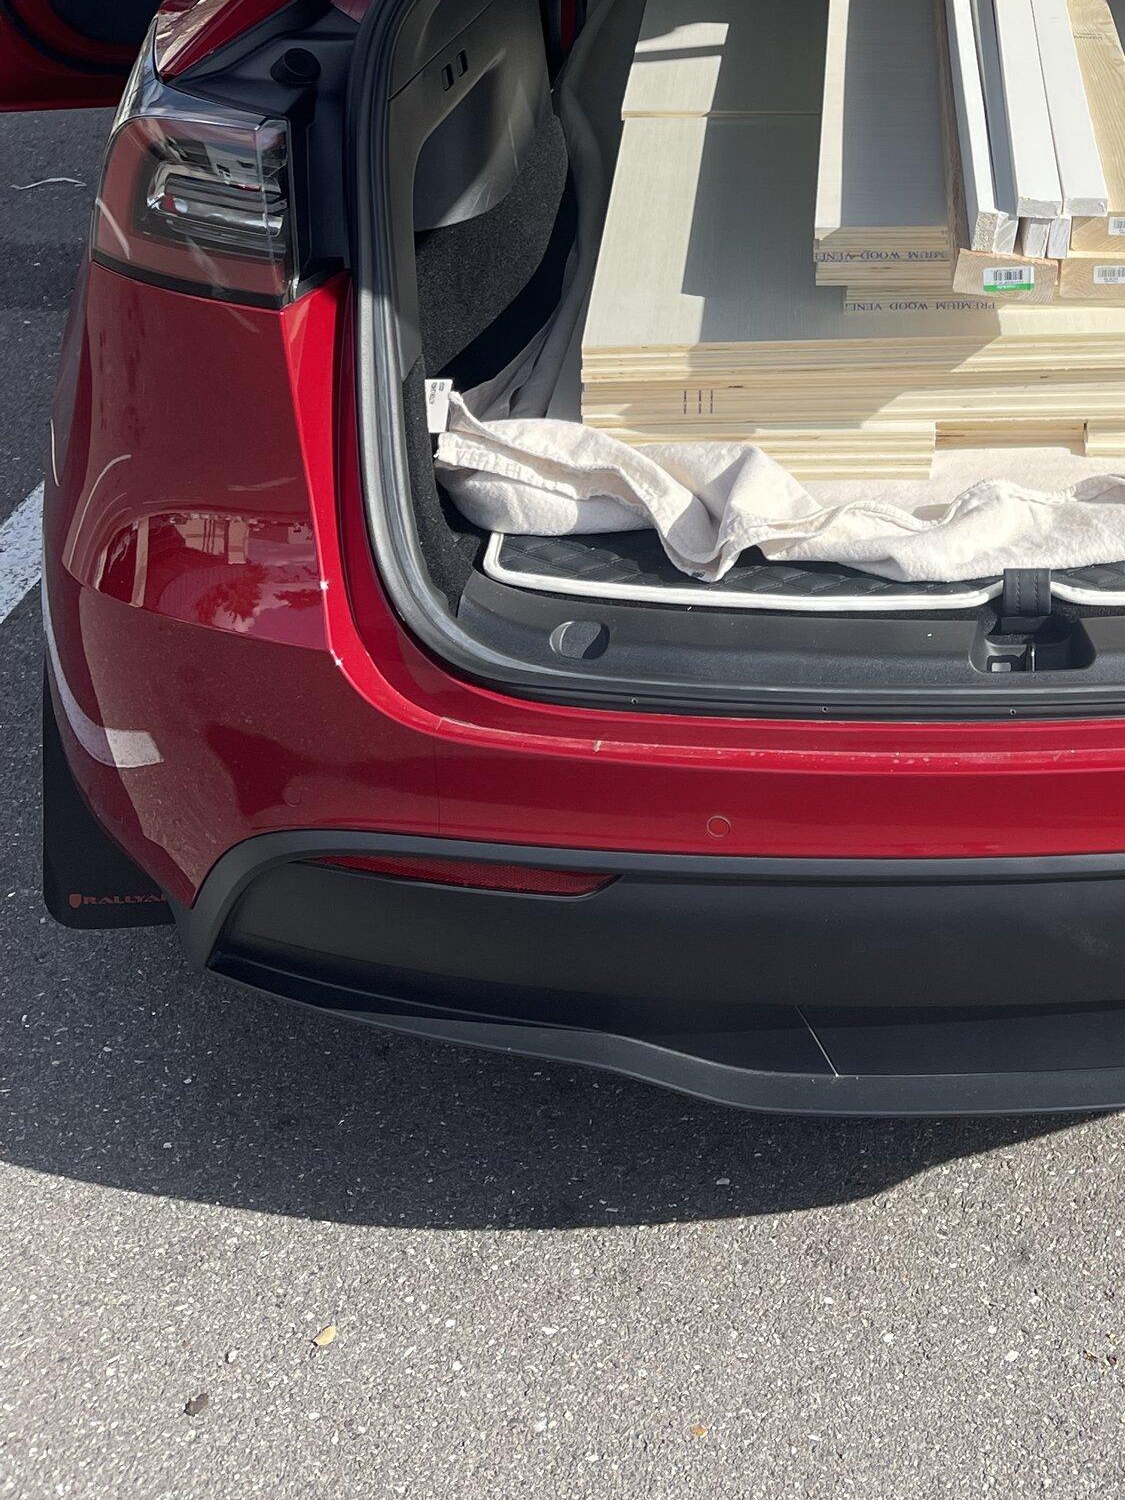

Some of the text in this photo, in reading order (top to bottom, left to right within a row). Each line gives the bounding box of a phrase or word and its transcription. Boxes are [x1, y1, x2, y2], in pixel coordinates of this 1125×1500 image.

[860, 251, 901, 260] WOOD
[845, 301, 996, 311] PREMIUM WOOD VENE
